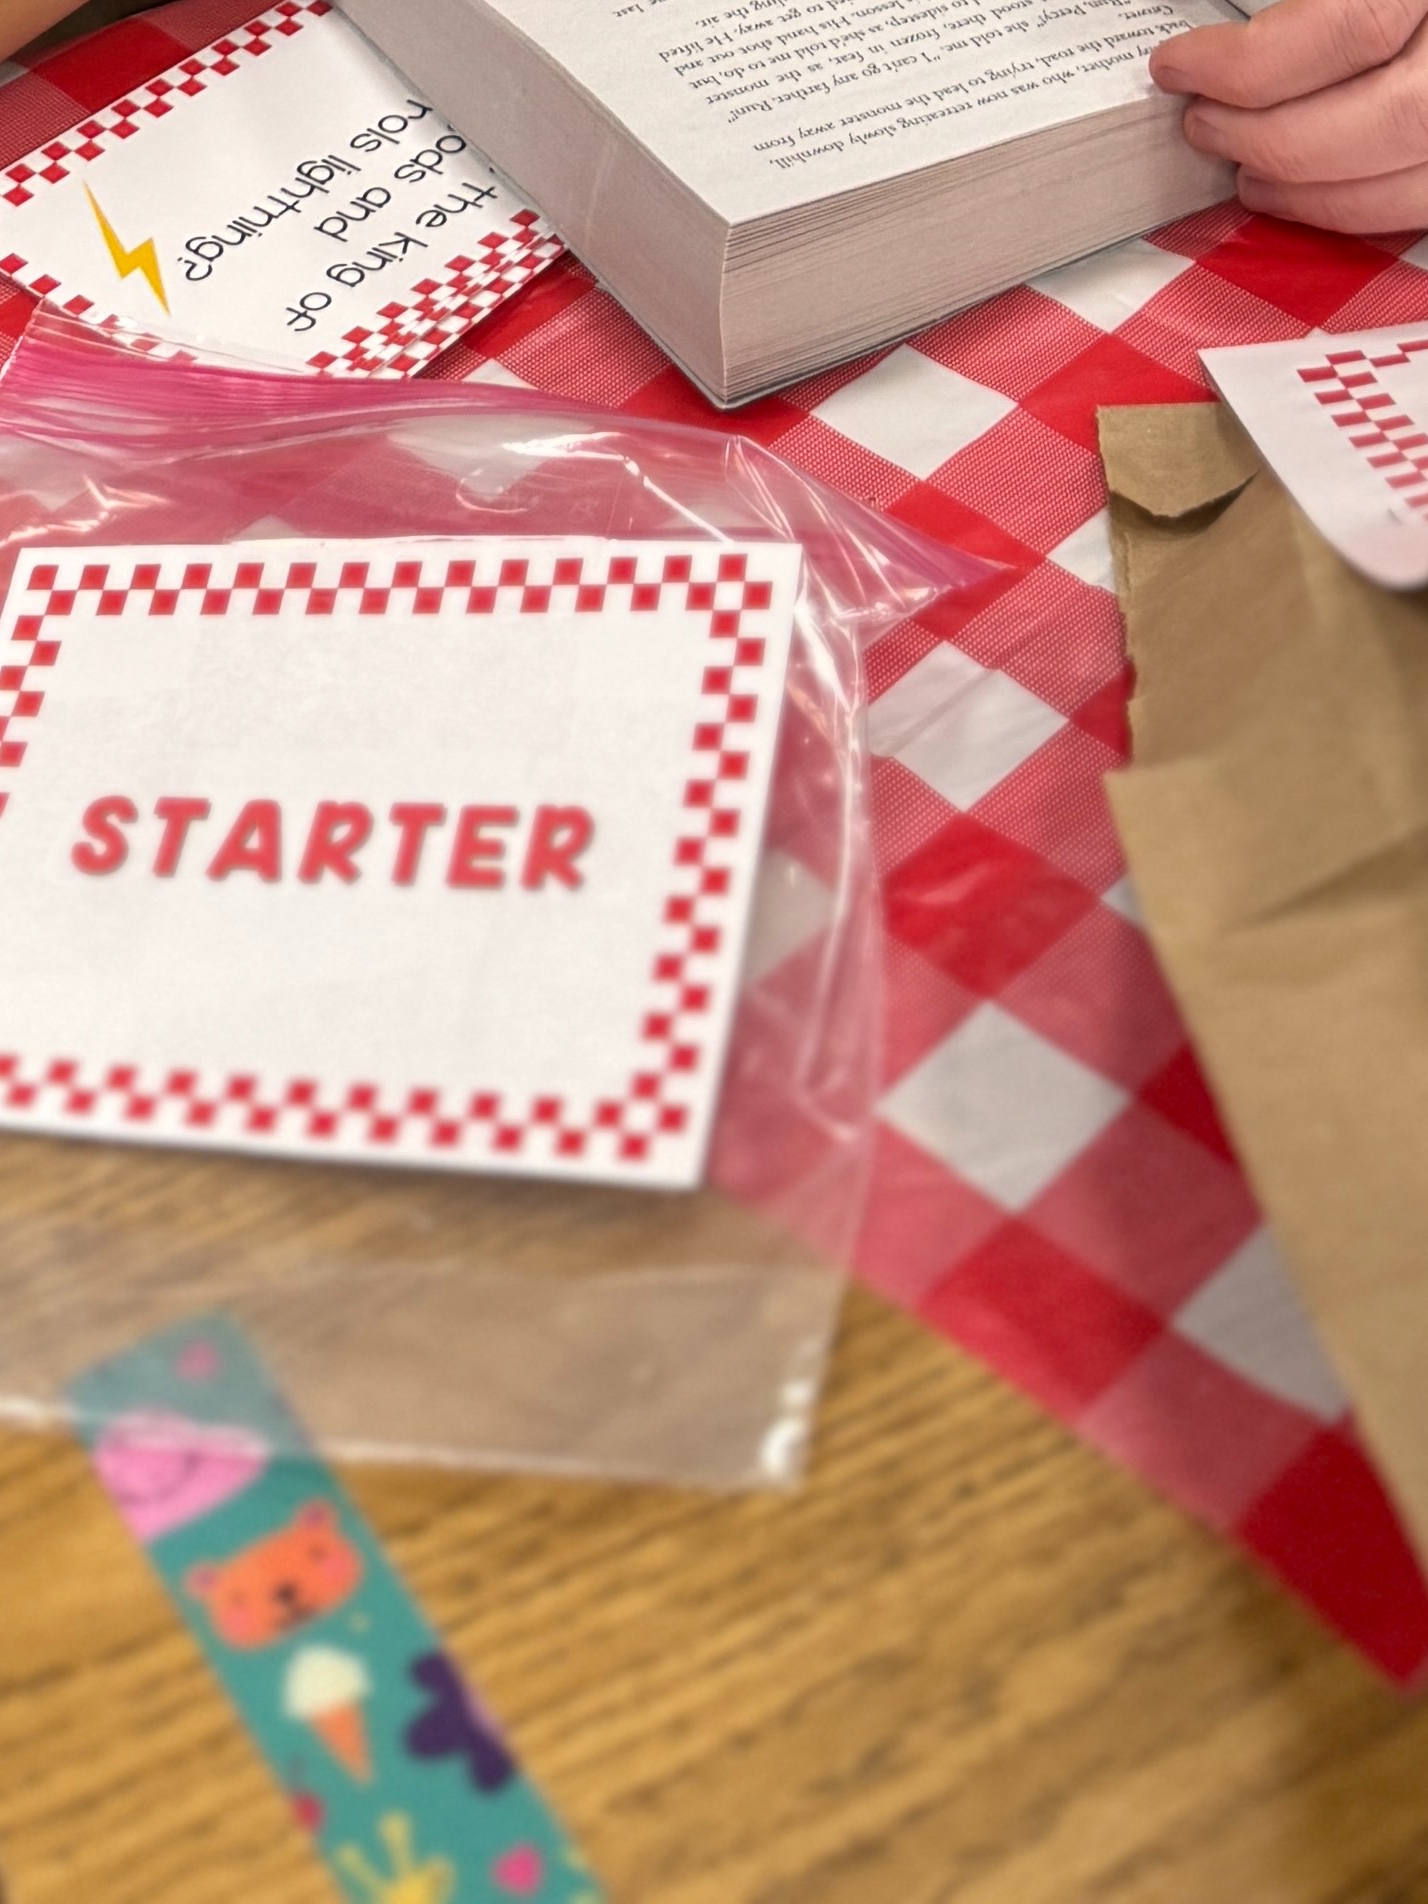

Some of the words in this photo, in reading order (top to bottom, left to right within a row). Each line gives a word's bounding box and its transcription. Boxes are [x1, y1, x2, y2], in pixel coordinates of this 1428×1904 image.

[884, 4, 948, 26] sidestep,
[942, 13, 986, 30] there,
[867, 23, 884, 33] as
[1003, 20, 1029, 33] she
[1154, 20, 1190, 35] back
[827, 29, 866, 49] she'd
[889, 27, 940, 47] frozen
[939, 39, 969, 52] me.
[968, 28, 1003, 47] told
[1075, 39, 1102, 52] the
[1102, 27, 1155, 49] toward
[766, 51, 792, 64] me
[793, 41, 827, 59] told
[827, 50, 864, 65] fear,
[866, 43, 888, 54] in
[1034, 47, 1075, 68] road,
[747, 59, 766, 70] to
[806, 62, 823, 72] as
[860, 62, 881, 77] go
[881, 55, 917, 73] can't
[1075, 51, 1134, 72] mother,
[717, 66, 745, 79] do,
[775, 68, 802, 82] the
[831, 72, 859, 86] any
[983, 61, 1035, 81] trying
[1041, 69, 1075, 85] who
[688, 74, 722, 89] but
[967, 76, 986, 86] to
[1009, 81, 1040, 95] was
[705, 78, 769, 104] monster
[771, 81, 830, 103] farther.
[904, 93, 931, 106] the
[931, 82, 969, 101] lead
[976, 89, 1009, 106] now
[839, 101, 902, 126] monster
[895, 101, 973, 128] retreating
[797, 121, 835, 139] away
[848, 124, 897, 145] slowly
[752, 134, 796, 151] from
[392, 123, 468, 186] ods
[769, 140, 844, 169] downhill,
[313, 185, 393, 243] and
[415, 181, 498, 230] the
[179, 153, 362, 283] lightning?
[325, 229, 430, 294] king
[285, 288, 334, 333] of
[68, 792, 598, 892] STARTER
